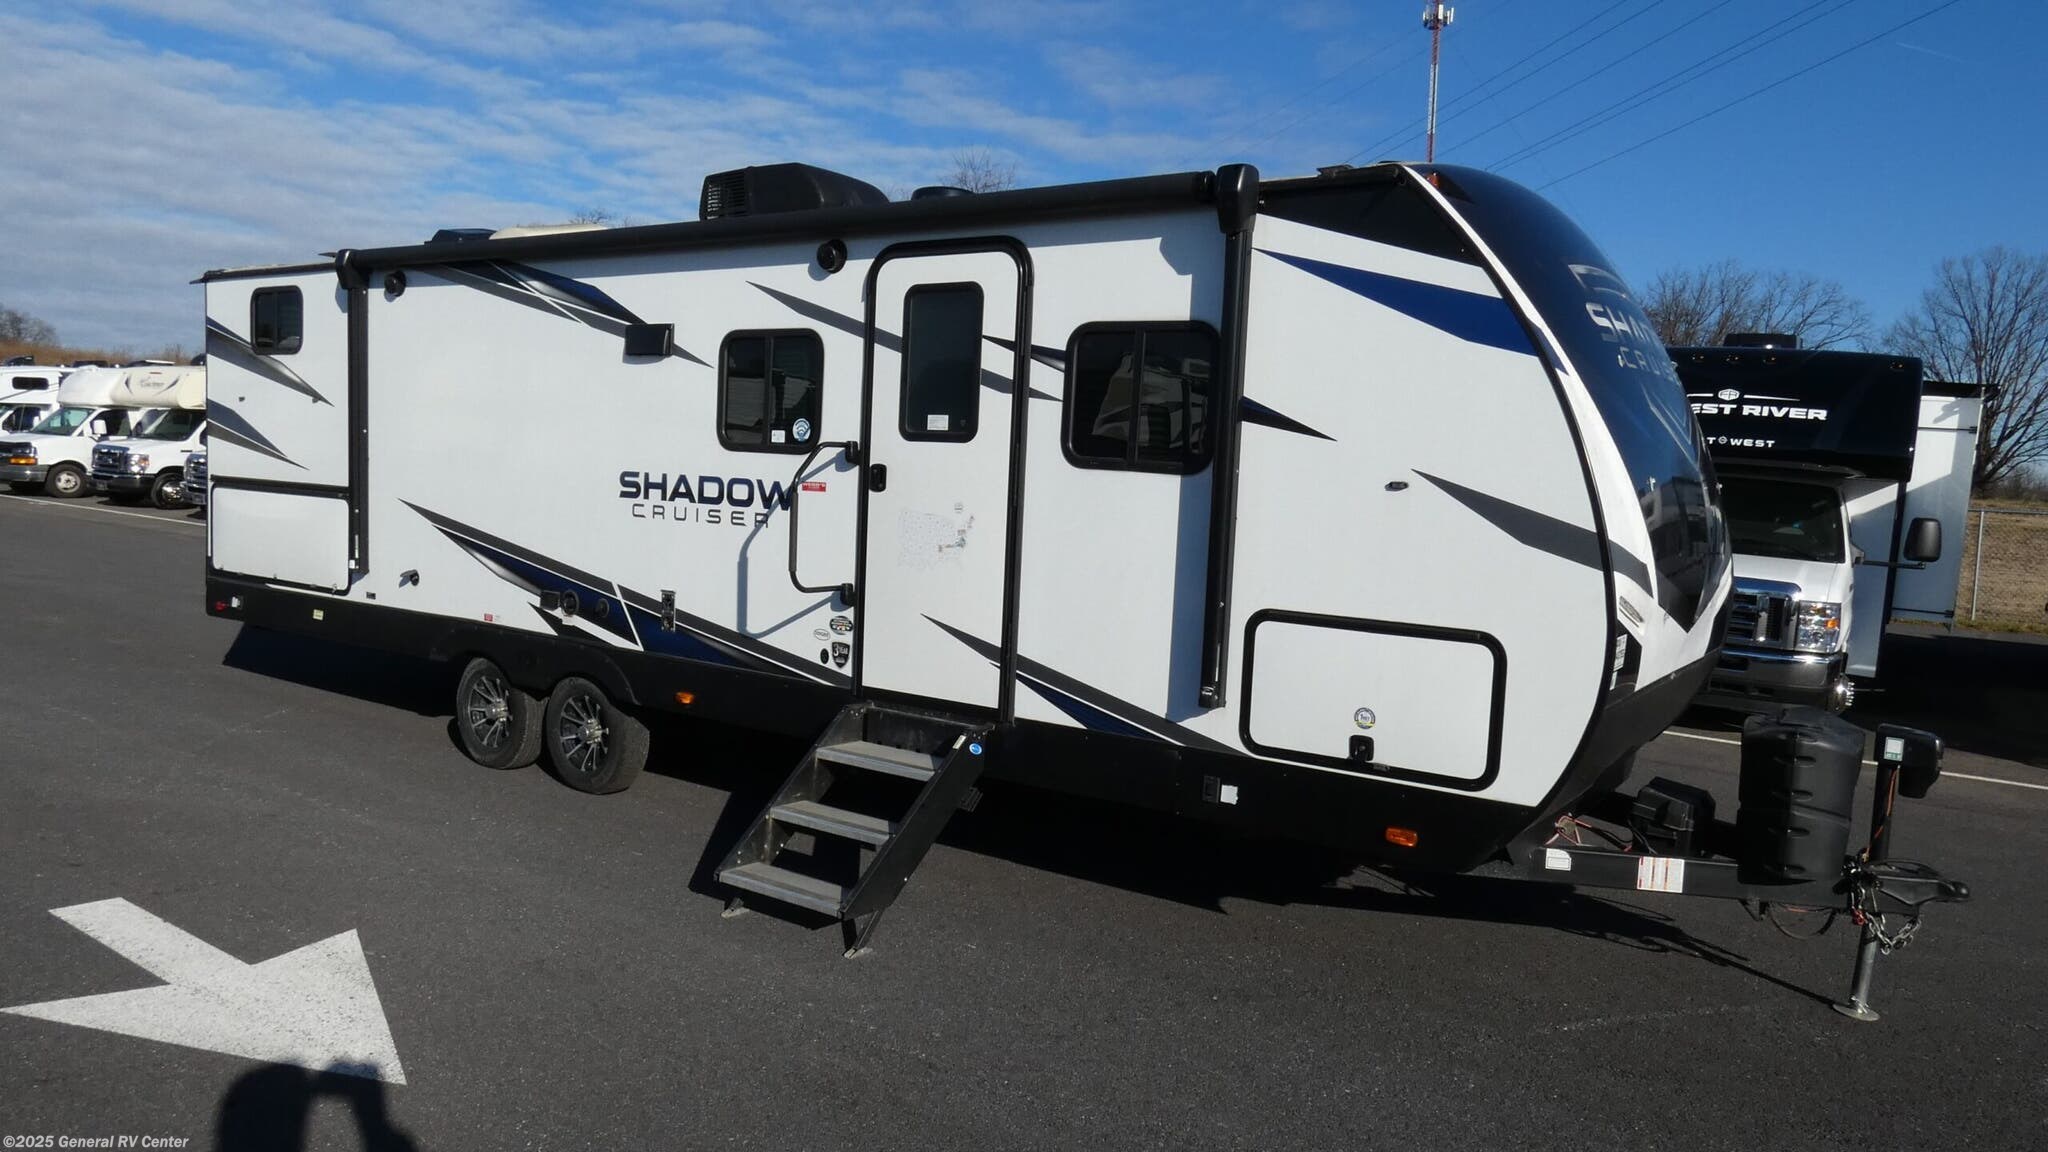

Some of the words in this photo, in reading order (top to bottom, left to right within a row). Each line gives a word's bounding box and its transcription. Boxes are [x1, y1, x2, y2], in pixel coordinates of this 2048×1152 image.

[1742, 404, 1828, 421] RIVER
[1729, 438, 1776, 448] WEST
[618, 470, 795, 511] SHADOW
[632, 503, 769, 528] CRUISER
